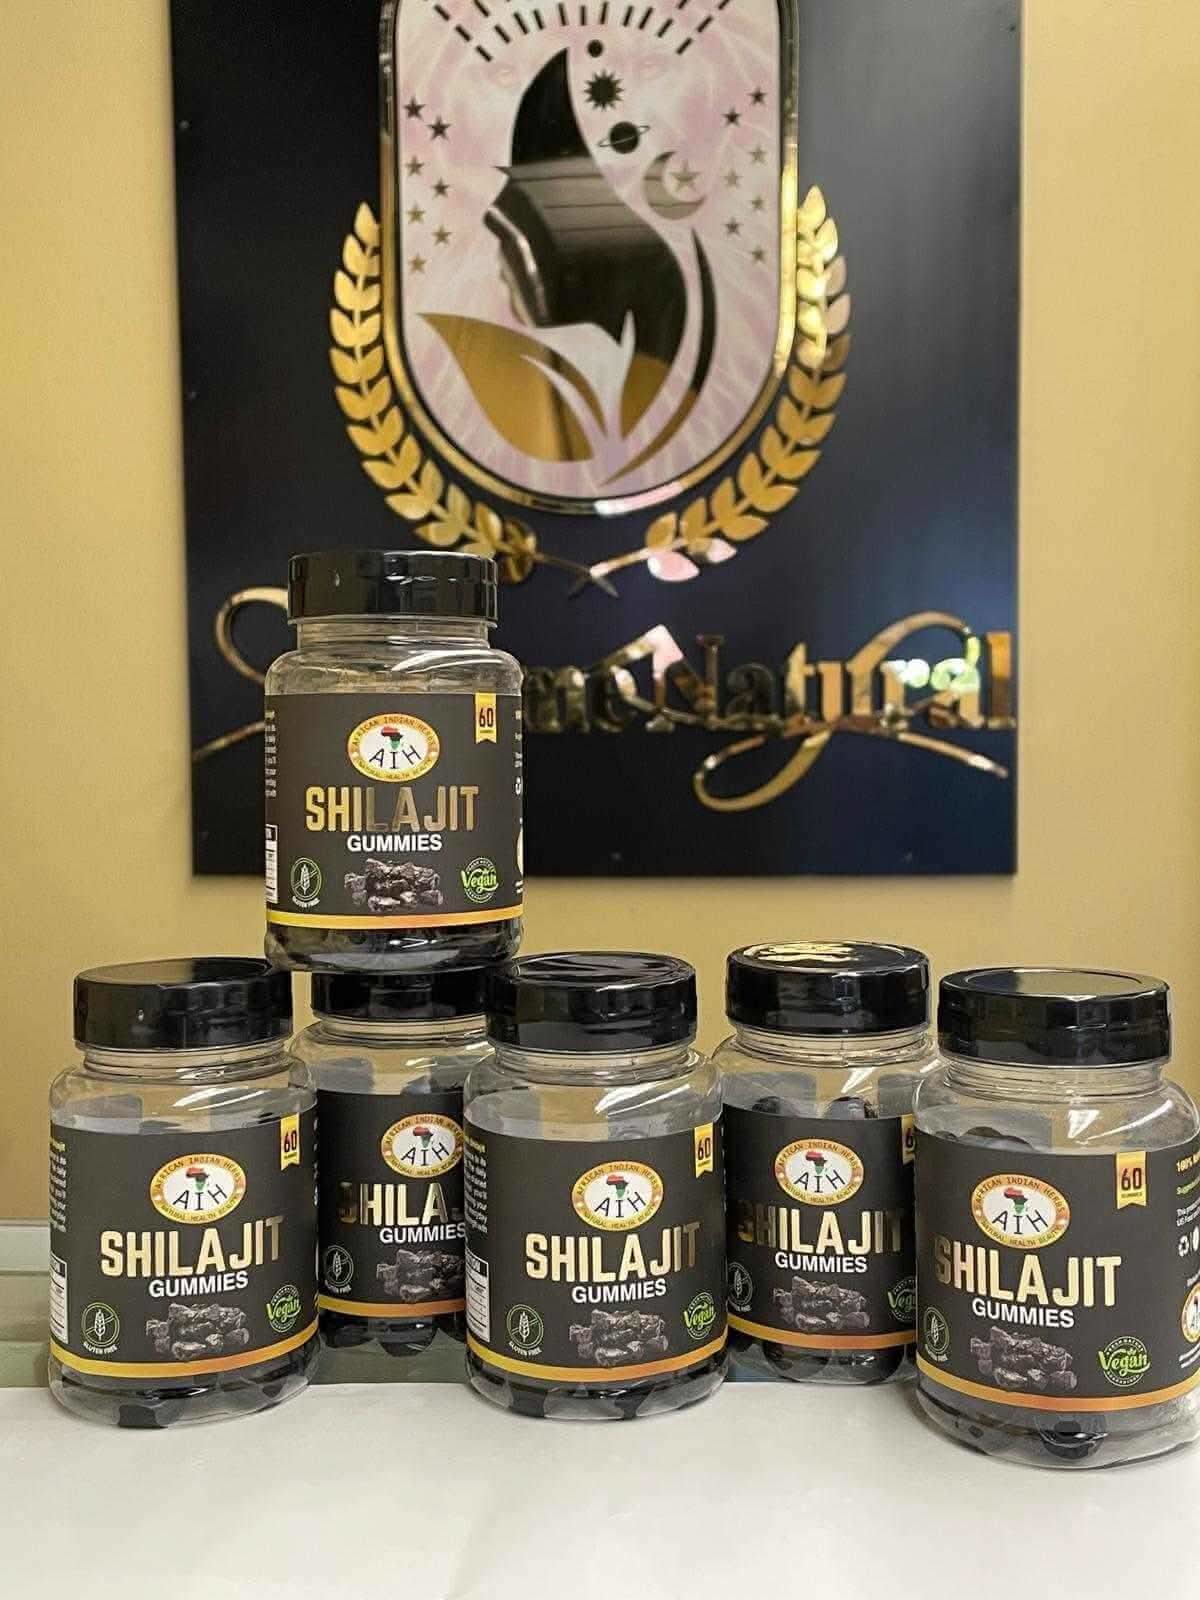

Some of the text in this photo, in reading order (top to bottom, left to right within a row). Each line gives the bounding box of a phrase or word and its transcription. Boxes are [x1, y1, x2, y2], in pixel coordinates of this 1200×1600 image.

[479, 707, 494, 728] 60
[368, 744, 422, 770] AIH
[305, 786, 479, 832] SHILAJIT
[347, 834, 443, 852] GUMMIES
[461, 868, 499, 893] Vegan
[284, 1130, 297, 1152] 60
[697, 1137, 711, 1161] 60
[400, 1142, 450, 1167] AIH
[793, 1168, 846, 1193] AIH
[975, 1178, 1002, 1204] AFRICAN
[1006, 1176, 1040, 1190] INDIAN
[1121, 1167, 1142, 1191] 60
[172, 1184, 228, 1211] AIH
[593, 1191, 647, 1218] AIH
[379, 1223, 466, 1244] GUMMIES
[991, 1208, 1049, 1235] AIH
[100, 1216, 285, 1278] SHILAJIT
[525, 1222, 701, 1283] SHILAJIT
[775, 1252, 868, 1273] GUMMIES
[934, 1233, 1122, 1308] SHILAJIT
[149, 1270, 249, 1298] GUMMIES
[571, 1279, 667, 1304] GUMMIES
[266, 1297, 301, 1322] Vegan
[888, 1288, 915, 1312] Veg
[972, 1297, 1075, 1328] GUMMIES
[684, 1304, 716, 1330] Vegan
[1098, 1349, 1151, 1377] Vegan
